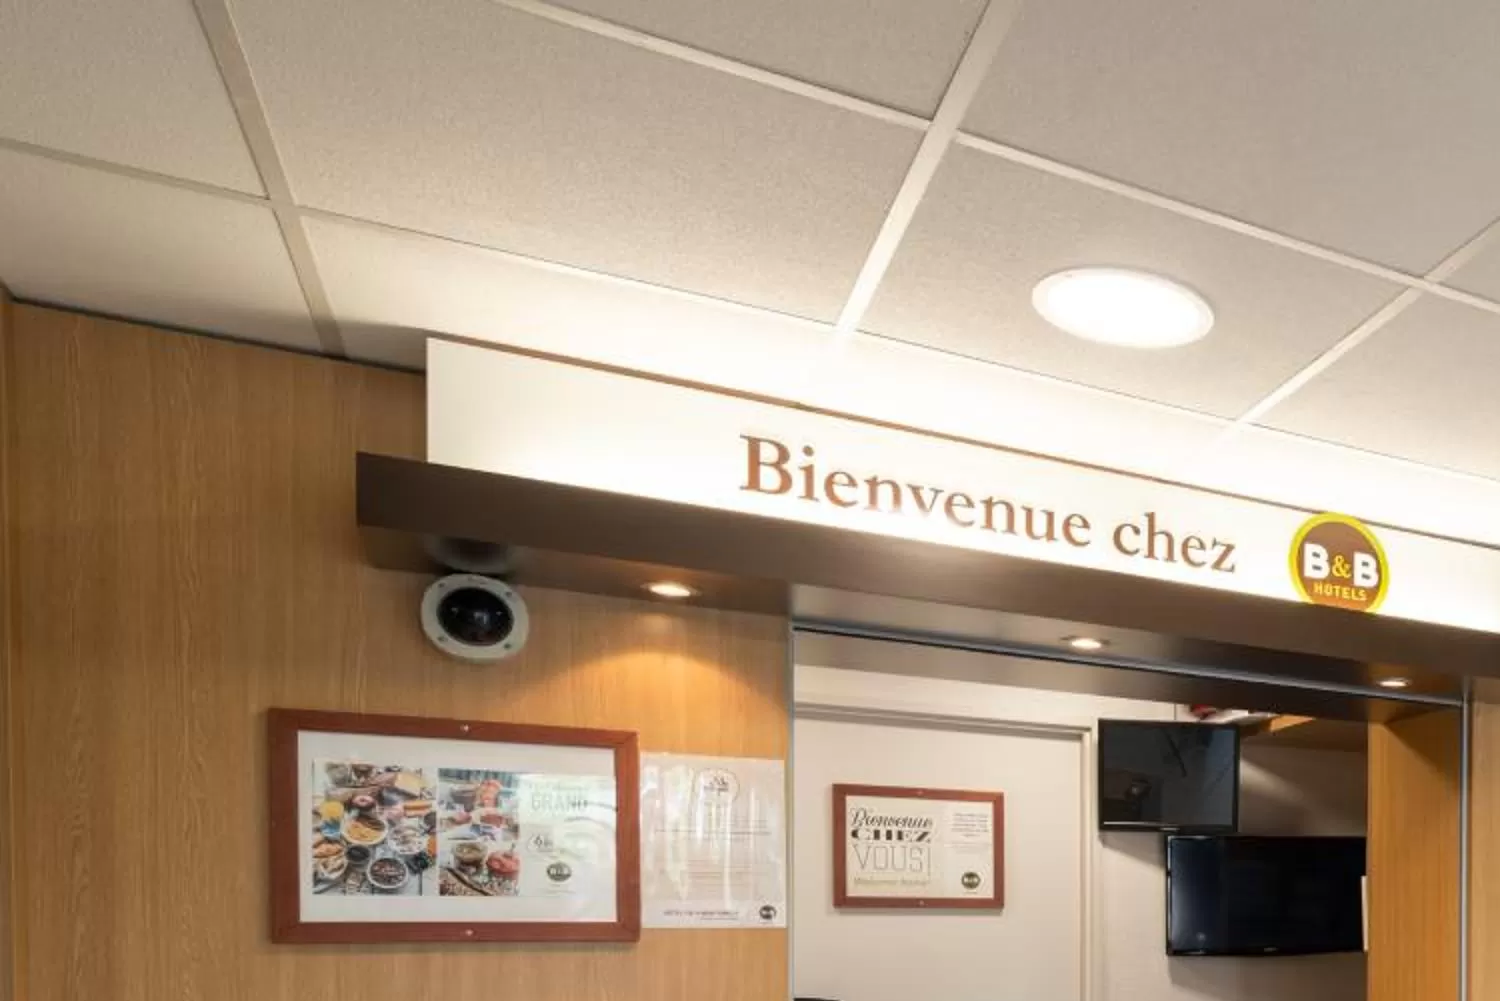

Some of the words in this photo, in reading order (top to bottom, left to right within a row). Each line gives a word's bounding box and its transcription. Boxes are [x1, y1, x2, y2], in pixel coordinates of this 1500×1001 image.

[739, 434, 1092, 547] Bienvenue
[1113, 511, 1237, 573] chez
[1302, 542, 1380, 588] B&B
[1312, 581, 1368, 602] HOTELS
